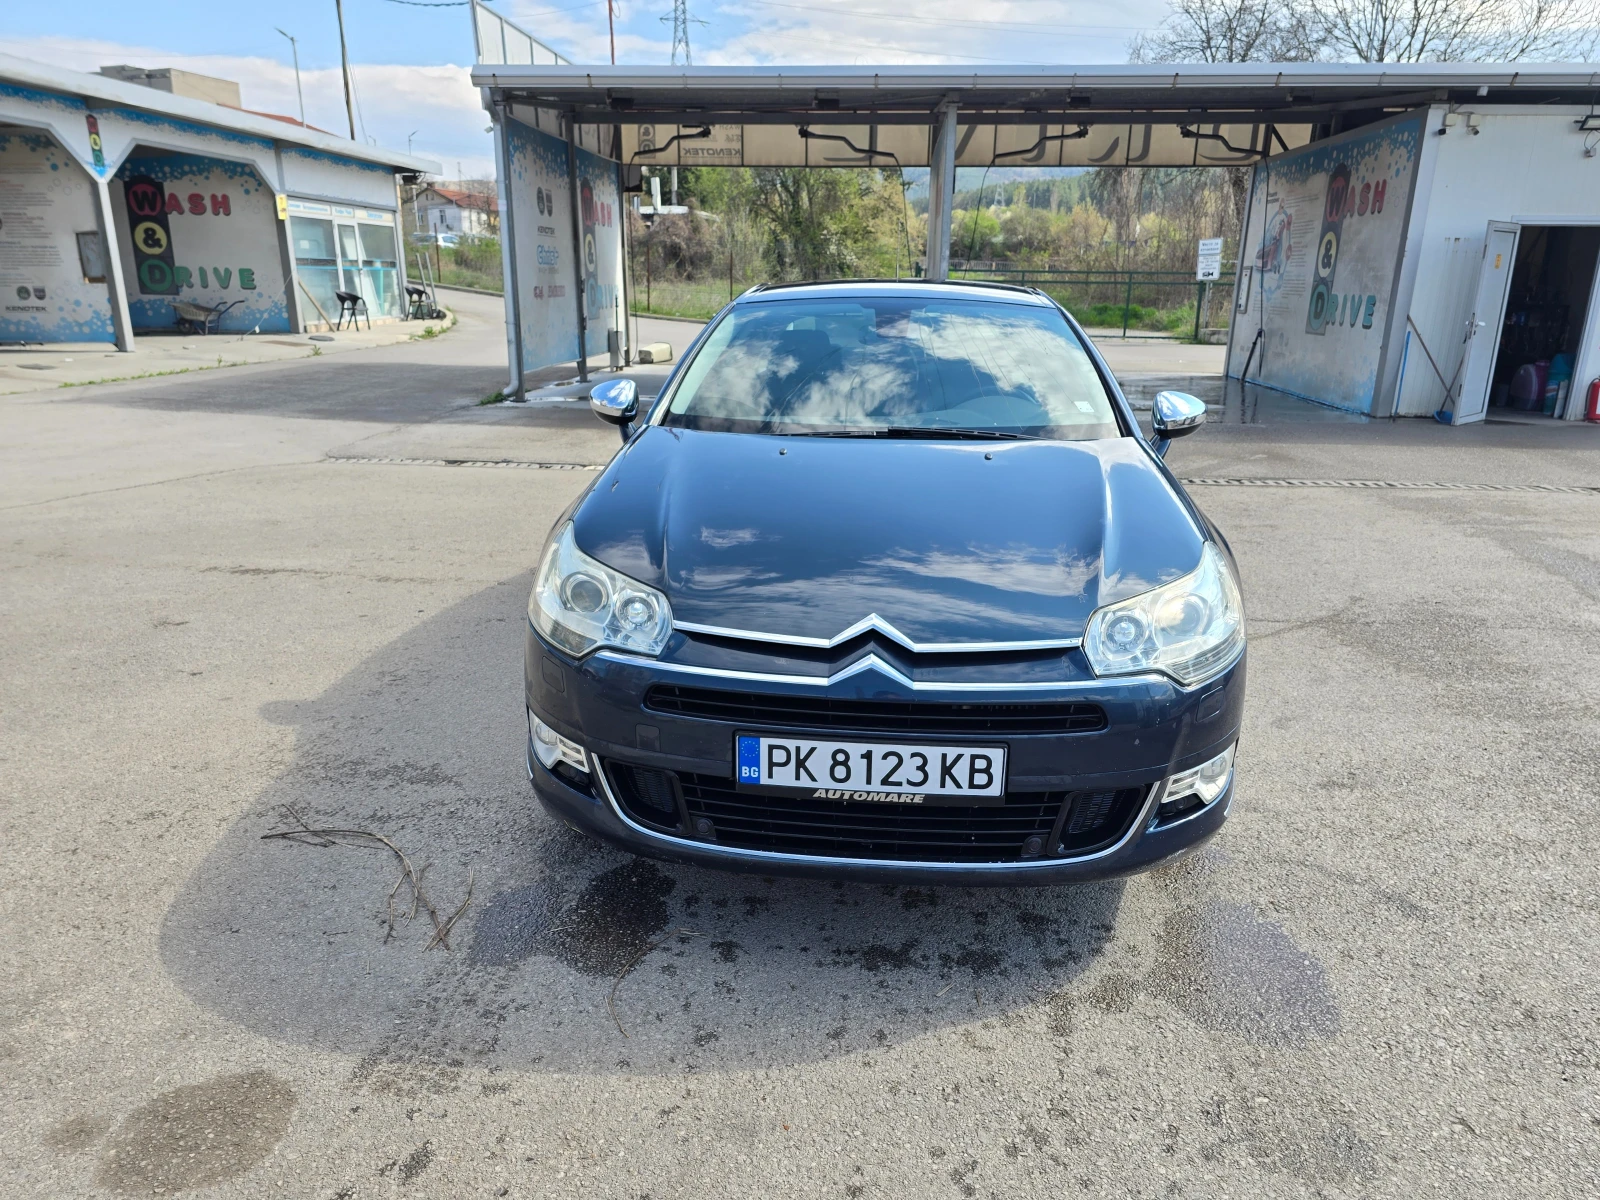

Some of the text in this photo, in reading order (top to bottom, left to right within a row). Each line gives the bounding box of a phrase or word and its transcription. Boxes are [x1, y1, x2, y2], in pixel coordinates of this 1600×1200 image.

[131, 190, 231, 216] WASH
[1328, 179, 1387, 218] WASH
[142, 227, 163, 249] &
[588, 239, 595, 265] &
[1321, 239, 1333, 270] &
[147, 264, 257, 290] DRIVE
[1313, 292, 1377, 329] DRIVE
[741, 766, 759, 778] BG
[766, 743, 995, 791] PK 8123 KB
[812, 788, 926, 805] AUTOMARE
